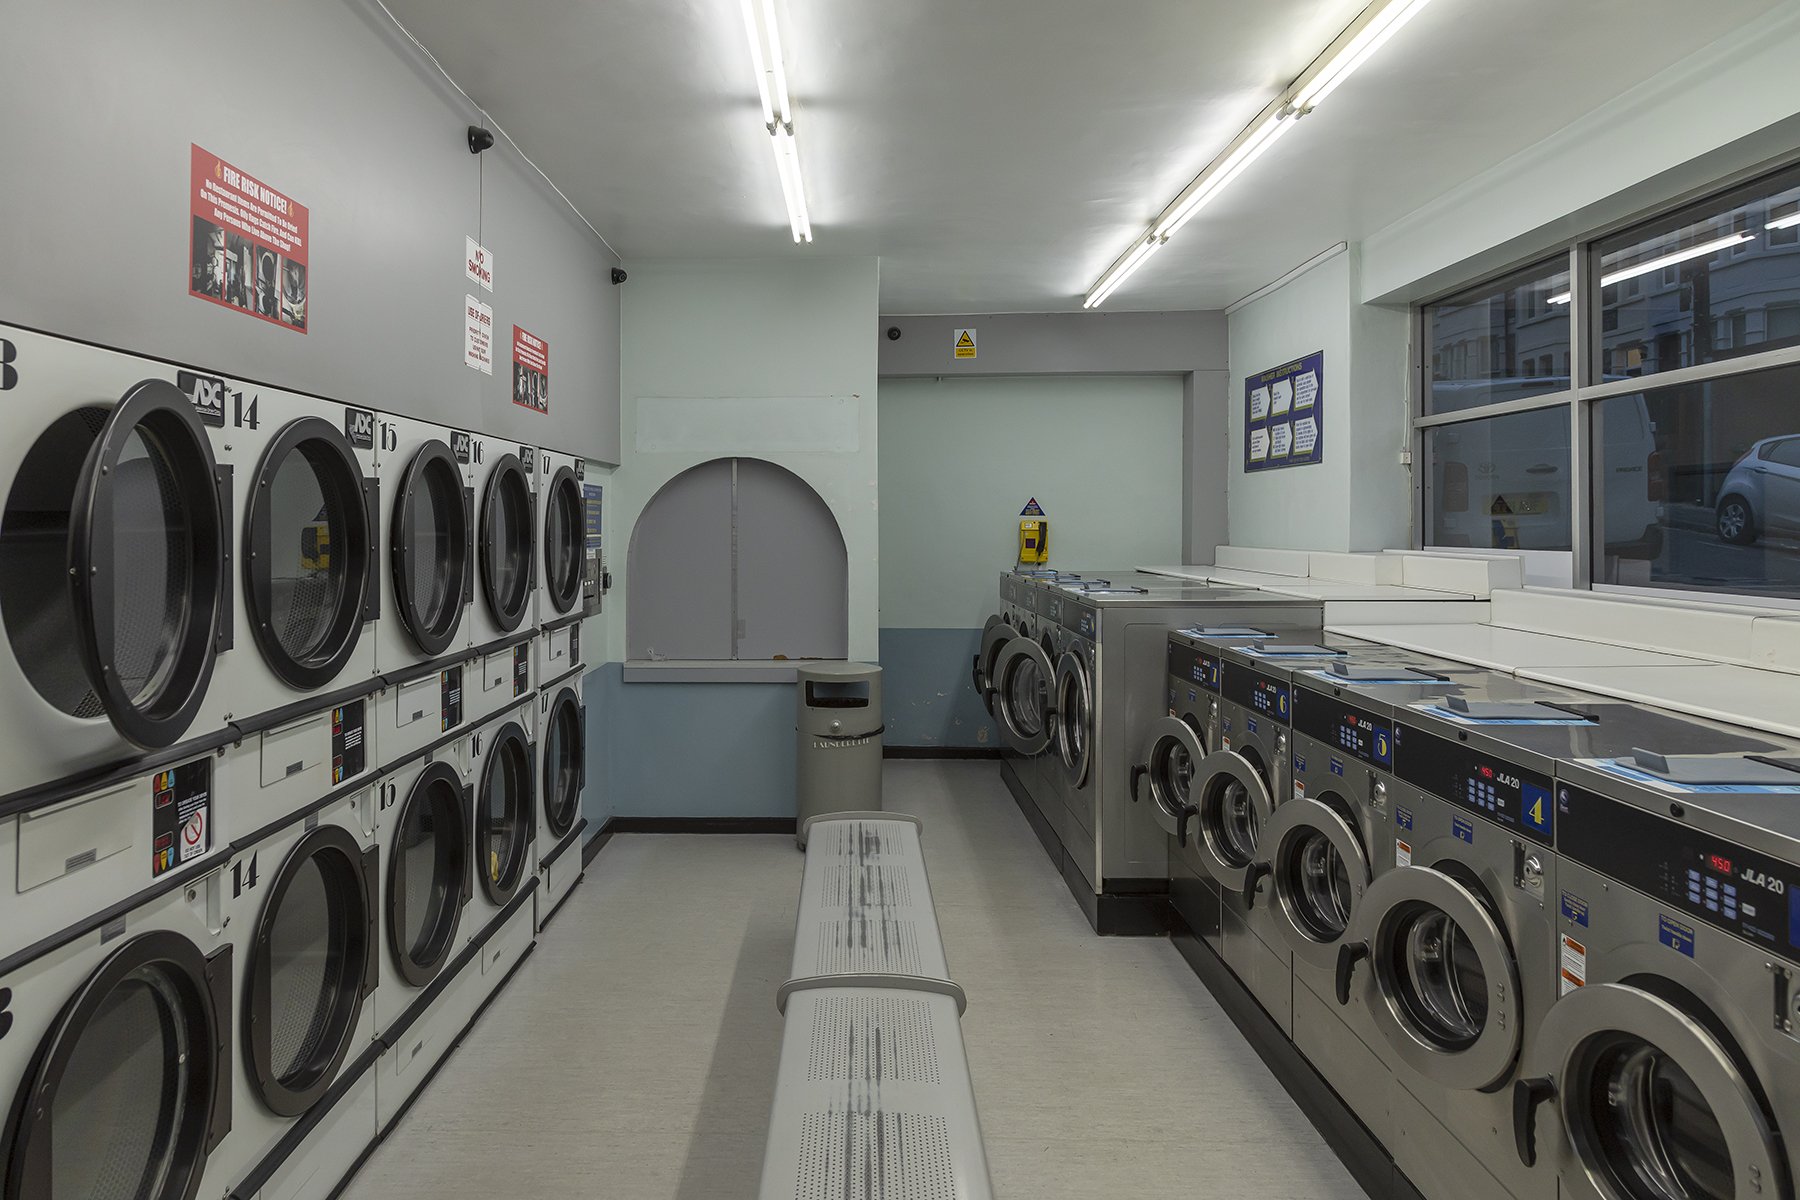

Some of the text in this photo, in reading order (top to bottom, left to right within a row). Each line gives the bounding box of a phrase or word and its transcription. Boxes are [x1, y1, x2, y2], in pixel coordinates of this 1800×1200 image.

[224, 166, 287, 215] FIRE RISK NOTICE!
[212, 182, 237, 202] Restaurant
[258, 206, 276, 223] Permitted
[475, 250, 484, 264] NO
[468, 259, 490, 282] SMOKING
[193, 378, 221, 408] ADC
[231, 392, 260, 430] 14
[355, 412, 371, 434] ADC
[380, 422, 397, 452] 15
[456, 435, 468, 452] ADC
[472, 441, 484, 465] 16
[543, 455, 551, 474] 17
[542, 693, 549, 714] 17
[1280, 695, 1287, 713] 6
[1358, 720, 1372, 731] JLA 20
[471, 731, 483, 758] 16
[1378, 733, 1387, 756] 5
[1497, 773, 1520, 789] JLA 20
[379, 777, 396, 811] 15
[1528, 796, 1544, 825] 4
[230, 850, 260, 899] 14
[1711, 855, 1731, 873] 450
[1740, 868, 1784, 895] JLA 20
